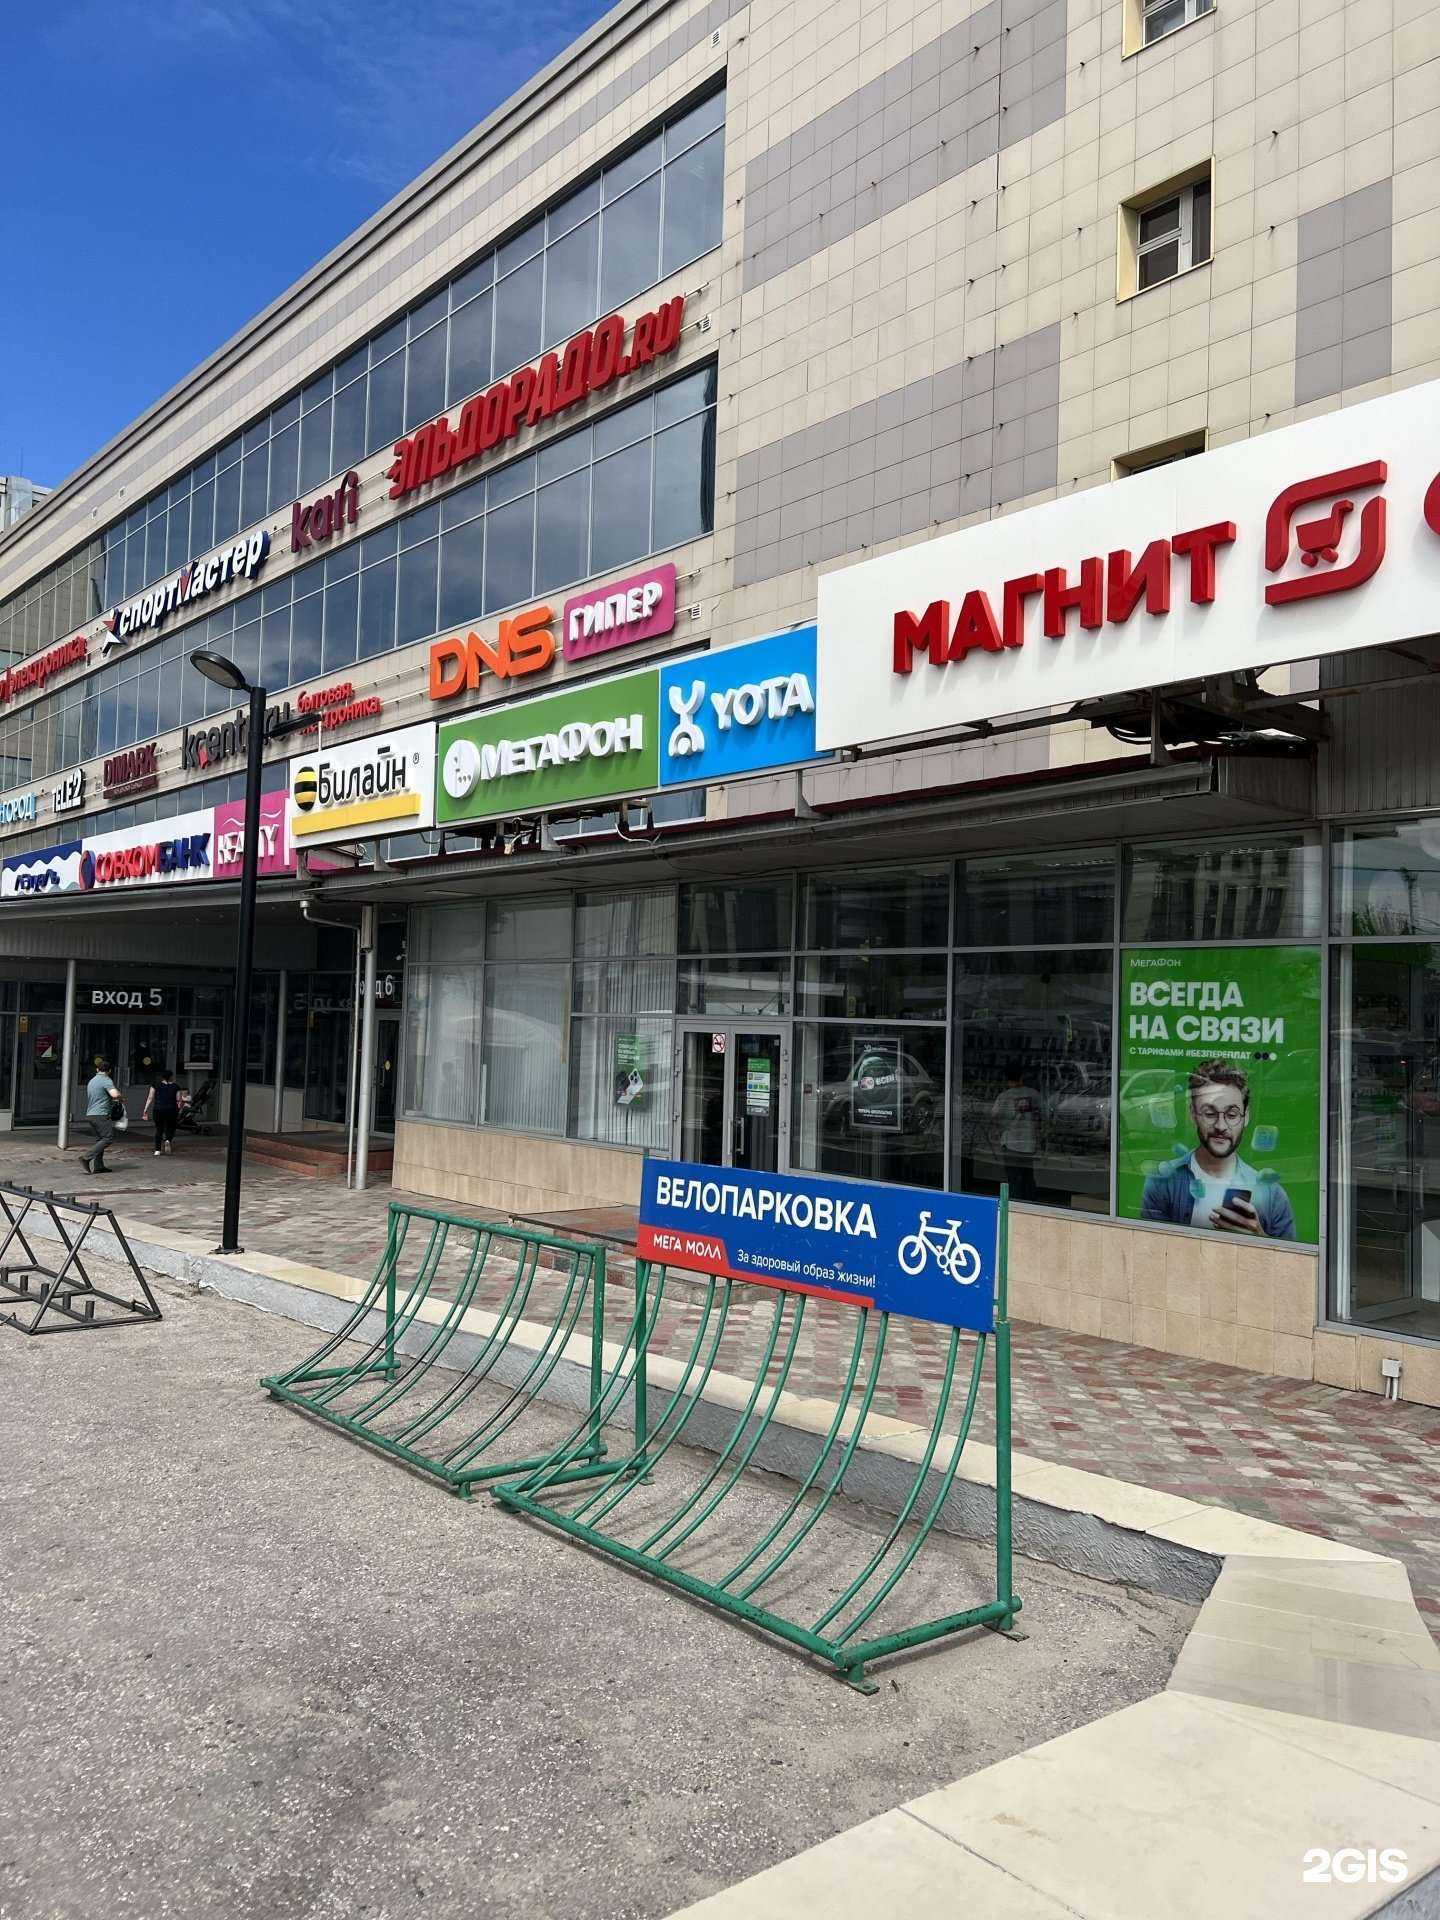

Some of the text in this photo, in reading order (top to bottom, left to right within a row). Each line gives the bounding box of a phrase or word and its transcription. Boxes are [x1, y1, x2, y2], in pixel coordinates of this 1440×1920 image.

[569, 581, 663, 643] ГИПЕР
[893, 521, 1236, 674] МАГНИТ
[430, 603, 555, 700] DNS
[710, 672, 815, 732] YOTA
[480, 713, 644, 781] МЕГАФОН
[52, 768, 86, 813] TELE2
[95, 833, 211, 883] СОВКОМБАНК
[149, 987, 162, 1006] 5
[385, 974, 393, 996] 6
[1130, 981, 1244, 1011] ВСЕГДА
[1129, 1015, 1285, 1044] НА СВЯЗИ
[1129, 1047, 1137, 1055] С
[1137, 1047, 1184, 1057] ТАРИФАМИ
[656, 1175, 878, 1240] ВЕЛОПАРКОВКА
[653, 1233, 722, 1260] МЕГА МОЛЛ
[737, 1249, 877, 1288] За здоровый образ жизни!
